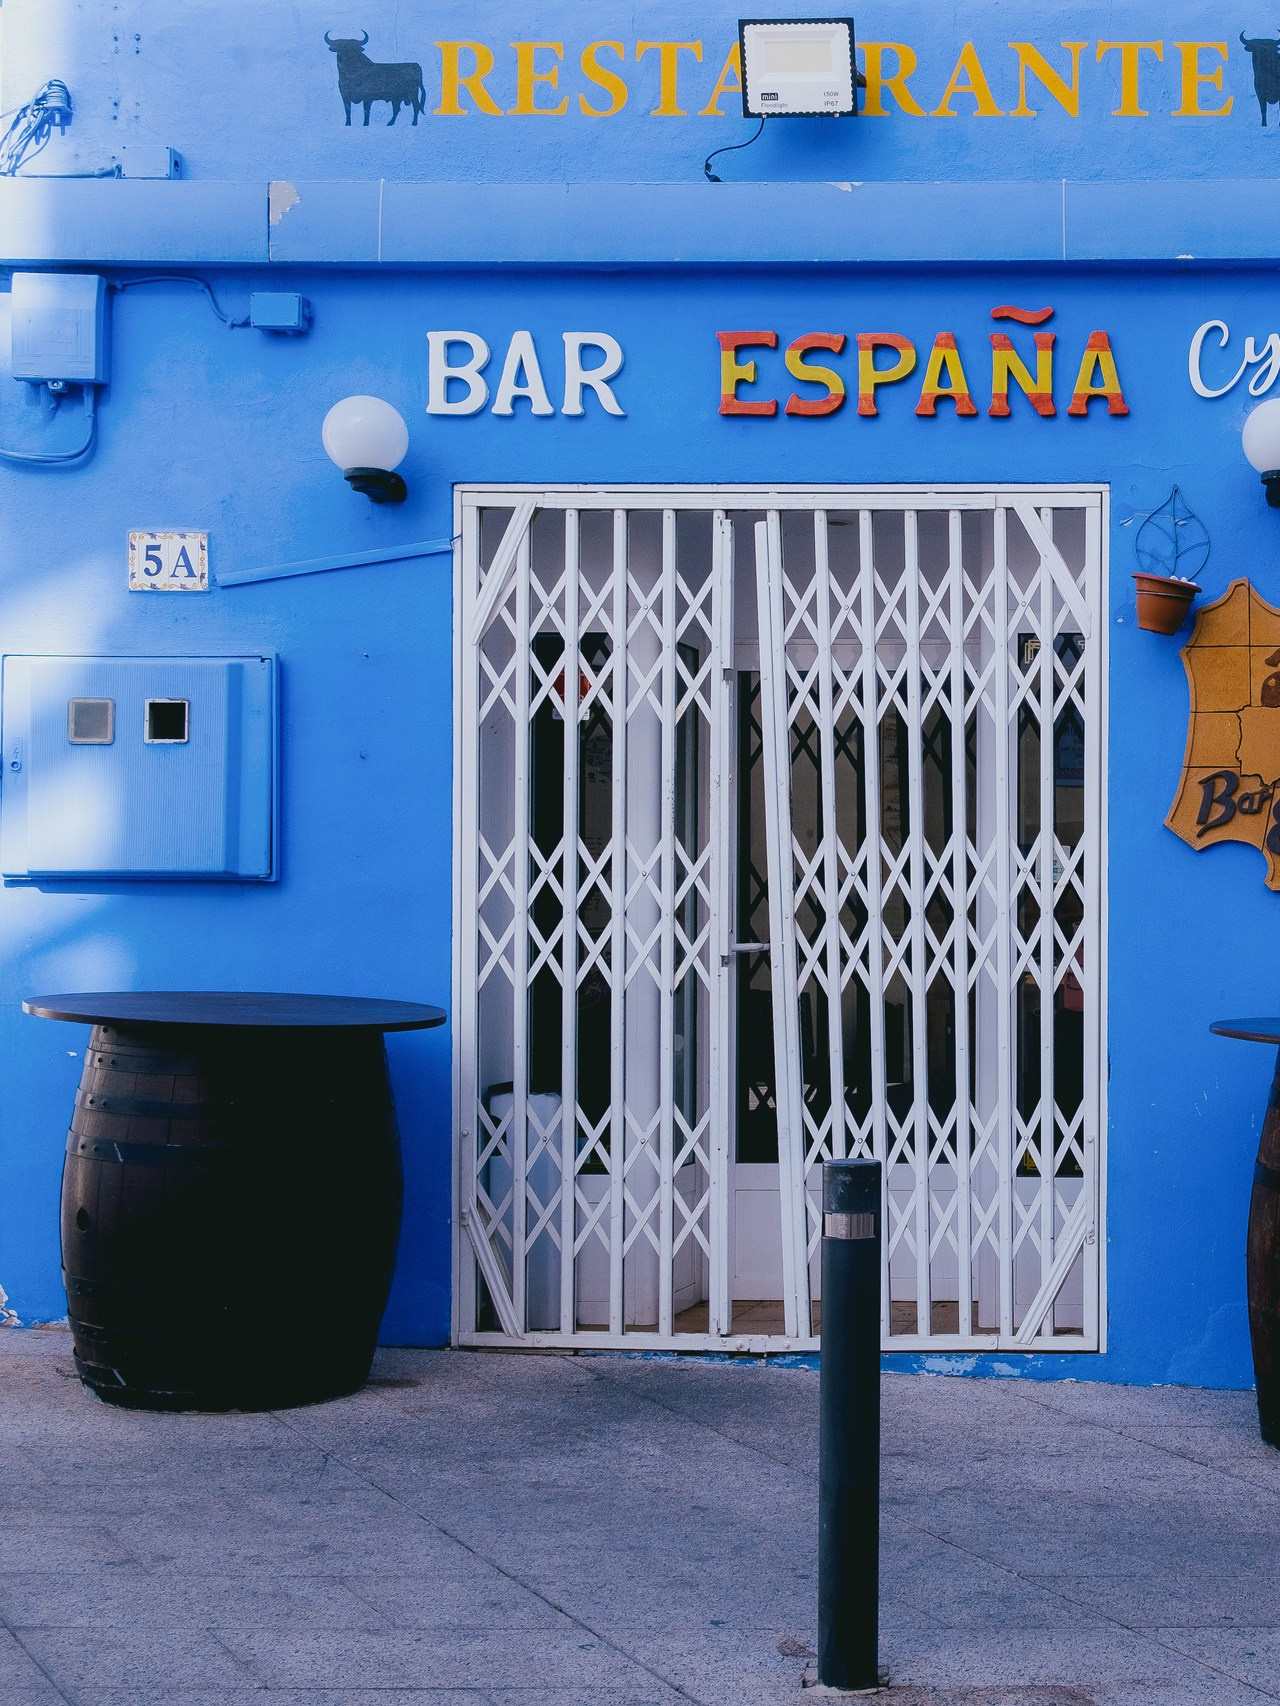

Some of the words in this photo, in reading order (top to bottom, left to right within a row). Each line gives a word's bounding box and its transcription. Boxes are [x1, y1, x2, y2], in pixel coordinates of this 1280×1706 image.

[432, 40, 1235, 117] RESTARANTE
[425, 330, 628, 416] BAR
[715, 305, 1131, 416] ESPAÑA
[1196, 769, 1273, 838] Bar
